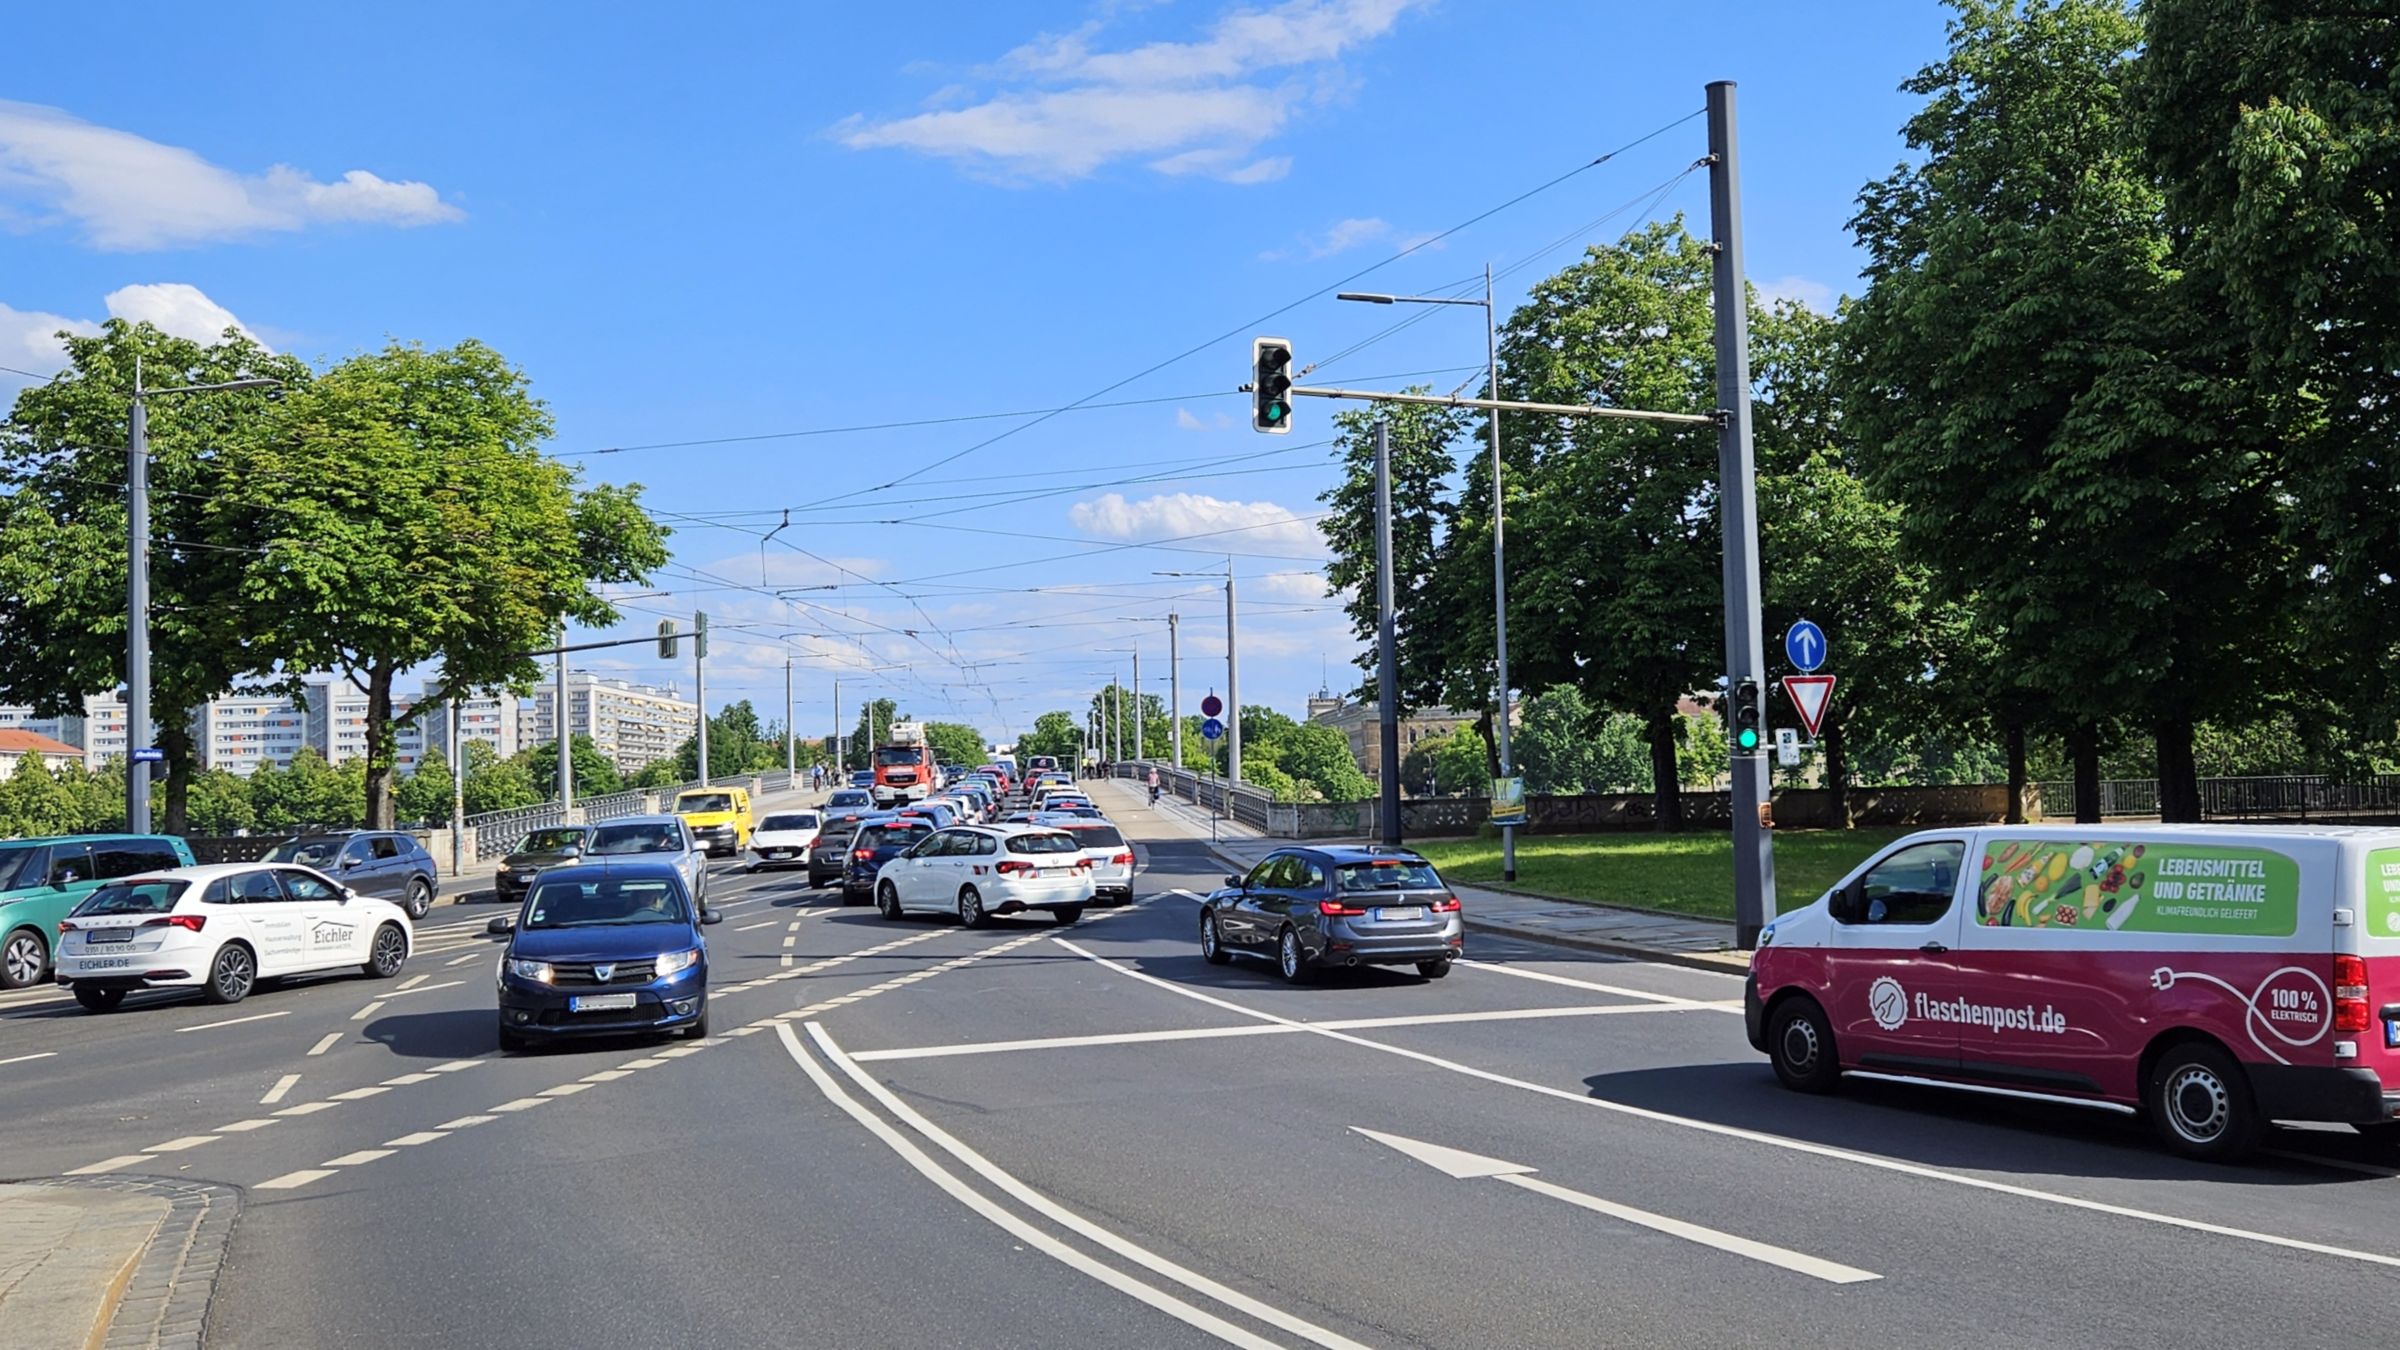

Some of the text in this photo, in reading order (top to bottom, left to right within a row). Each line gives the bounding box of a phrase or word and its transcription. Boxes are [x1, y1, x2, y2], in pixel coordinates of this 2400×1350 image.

[2158, 858, 2265, 878] LEBENSMITTEL
[2153, 878, 2266, 903] UND GETRÄNKE
[2156, 905, 2258, 920] KLIMAFREUNDLICH GELIEFERT
[314, 928, 353, 944] Eichler
[80, 959, 130, 970] EICHLER.DE
[2271, 989, 2317, 1010] 100 %
[1914, 992, 2066, 1034] flaschenpost.de
[2271, 1009, 2318, 1023] ELEKTRISCH
